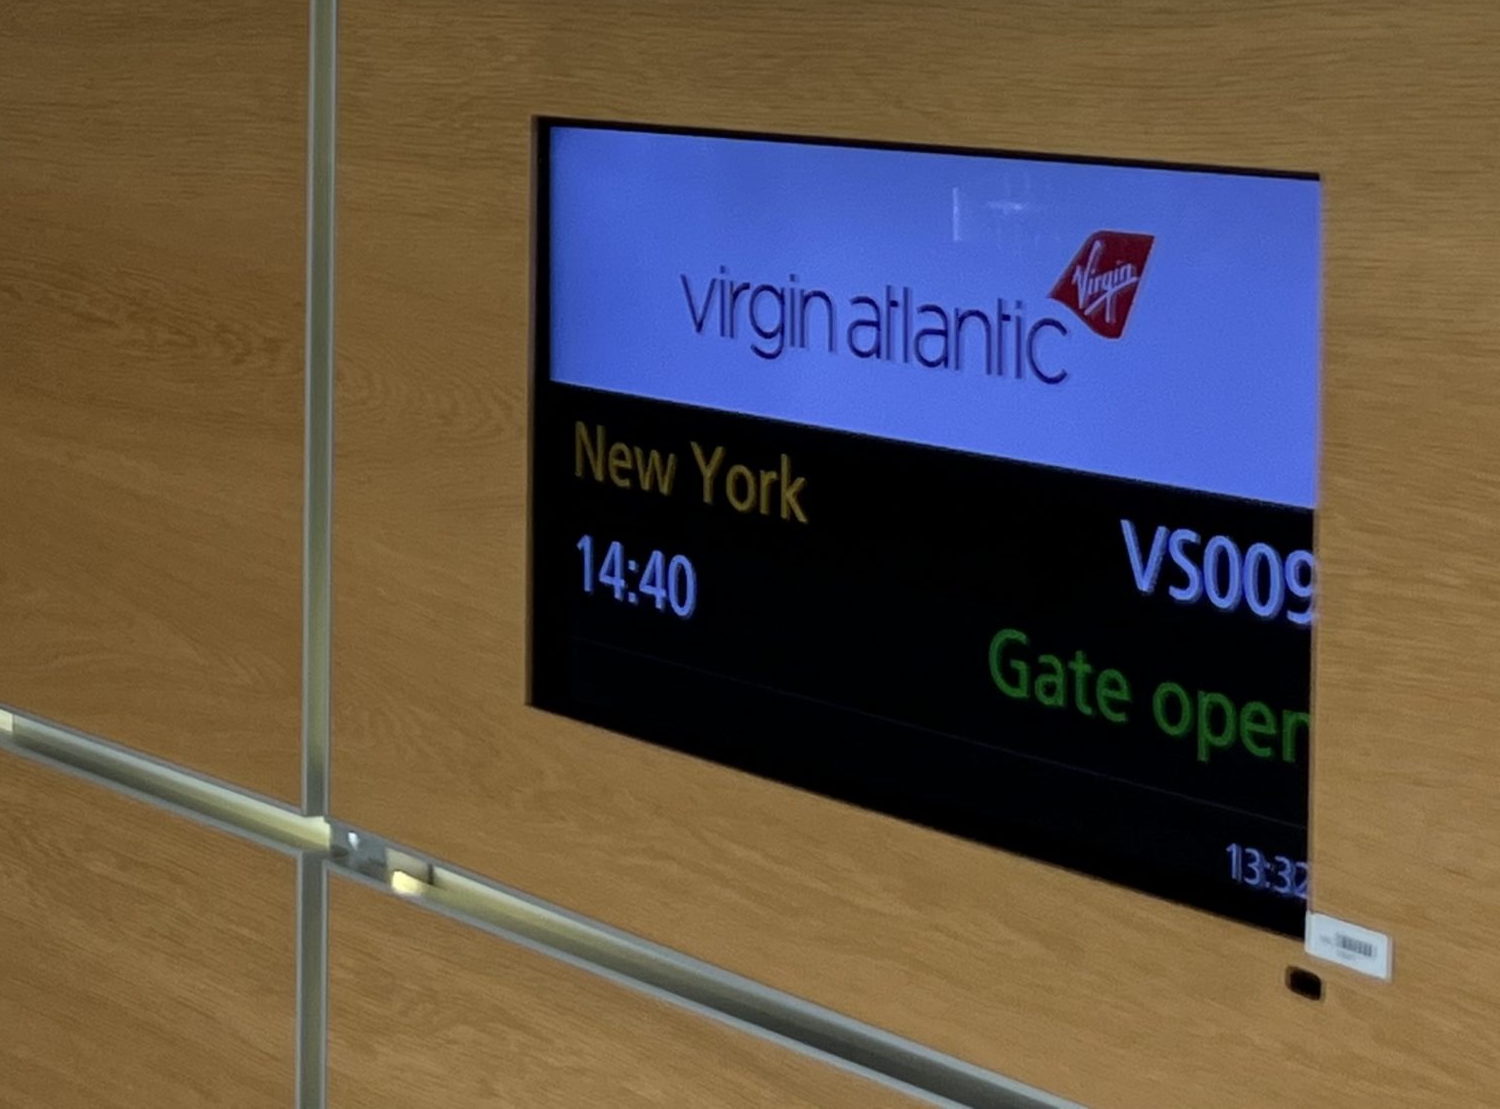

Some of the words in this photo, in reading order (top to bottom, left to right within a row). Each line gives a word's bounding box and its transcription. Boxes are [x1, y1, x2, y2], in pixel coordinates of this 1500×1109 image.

[679, 264, 836, 360] virgin
[846, 283, 1071, 386] atlantic
[1071, 240, 1139, 324] Virgin
[573, 420, 677, 496] New
[690, 440, 810, 524] York
[575, 534, 698, 620] 14:40
[1120, 519, 1317, 625] VS009
[988, 627, 1131, 724] Gate
[1225, 841, 1311, 901] 13:32
